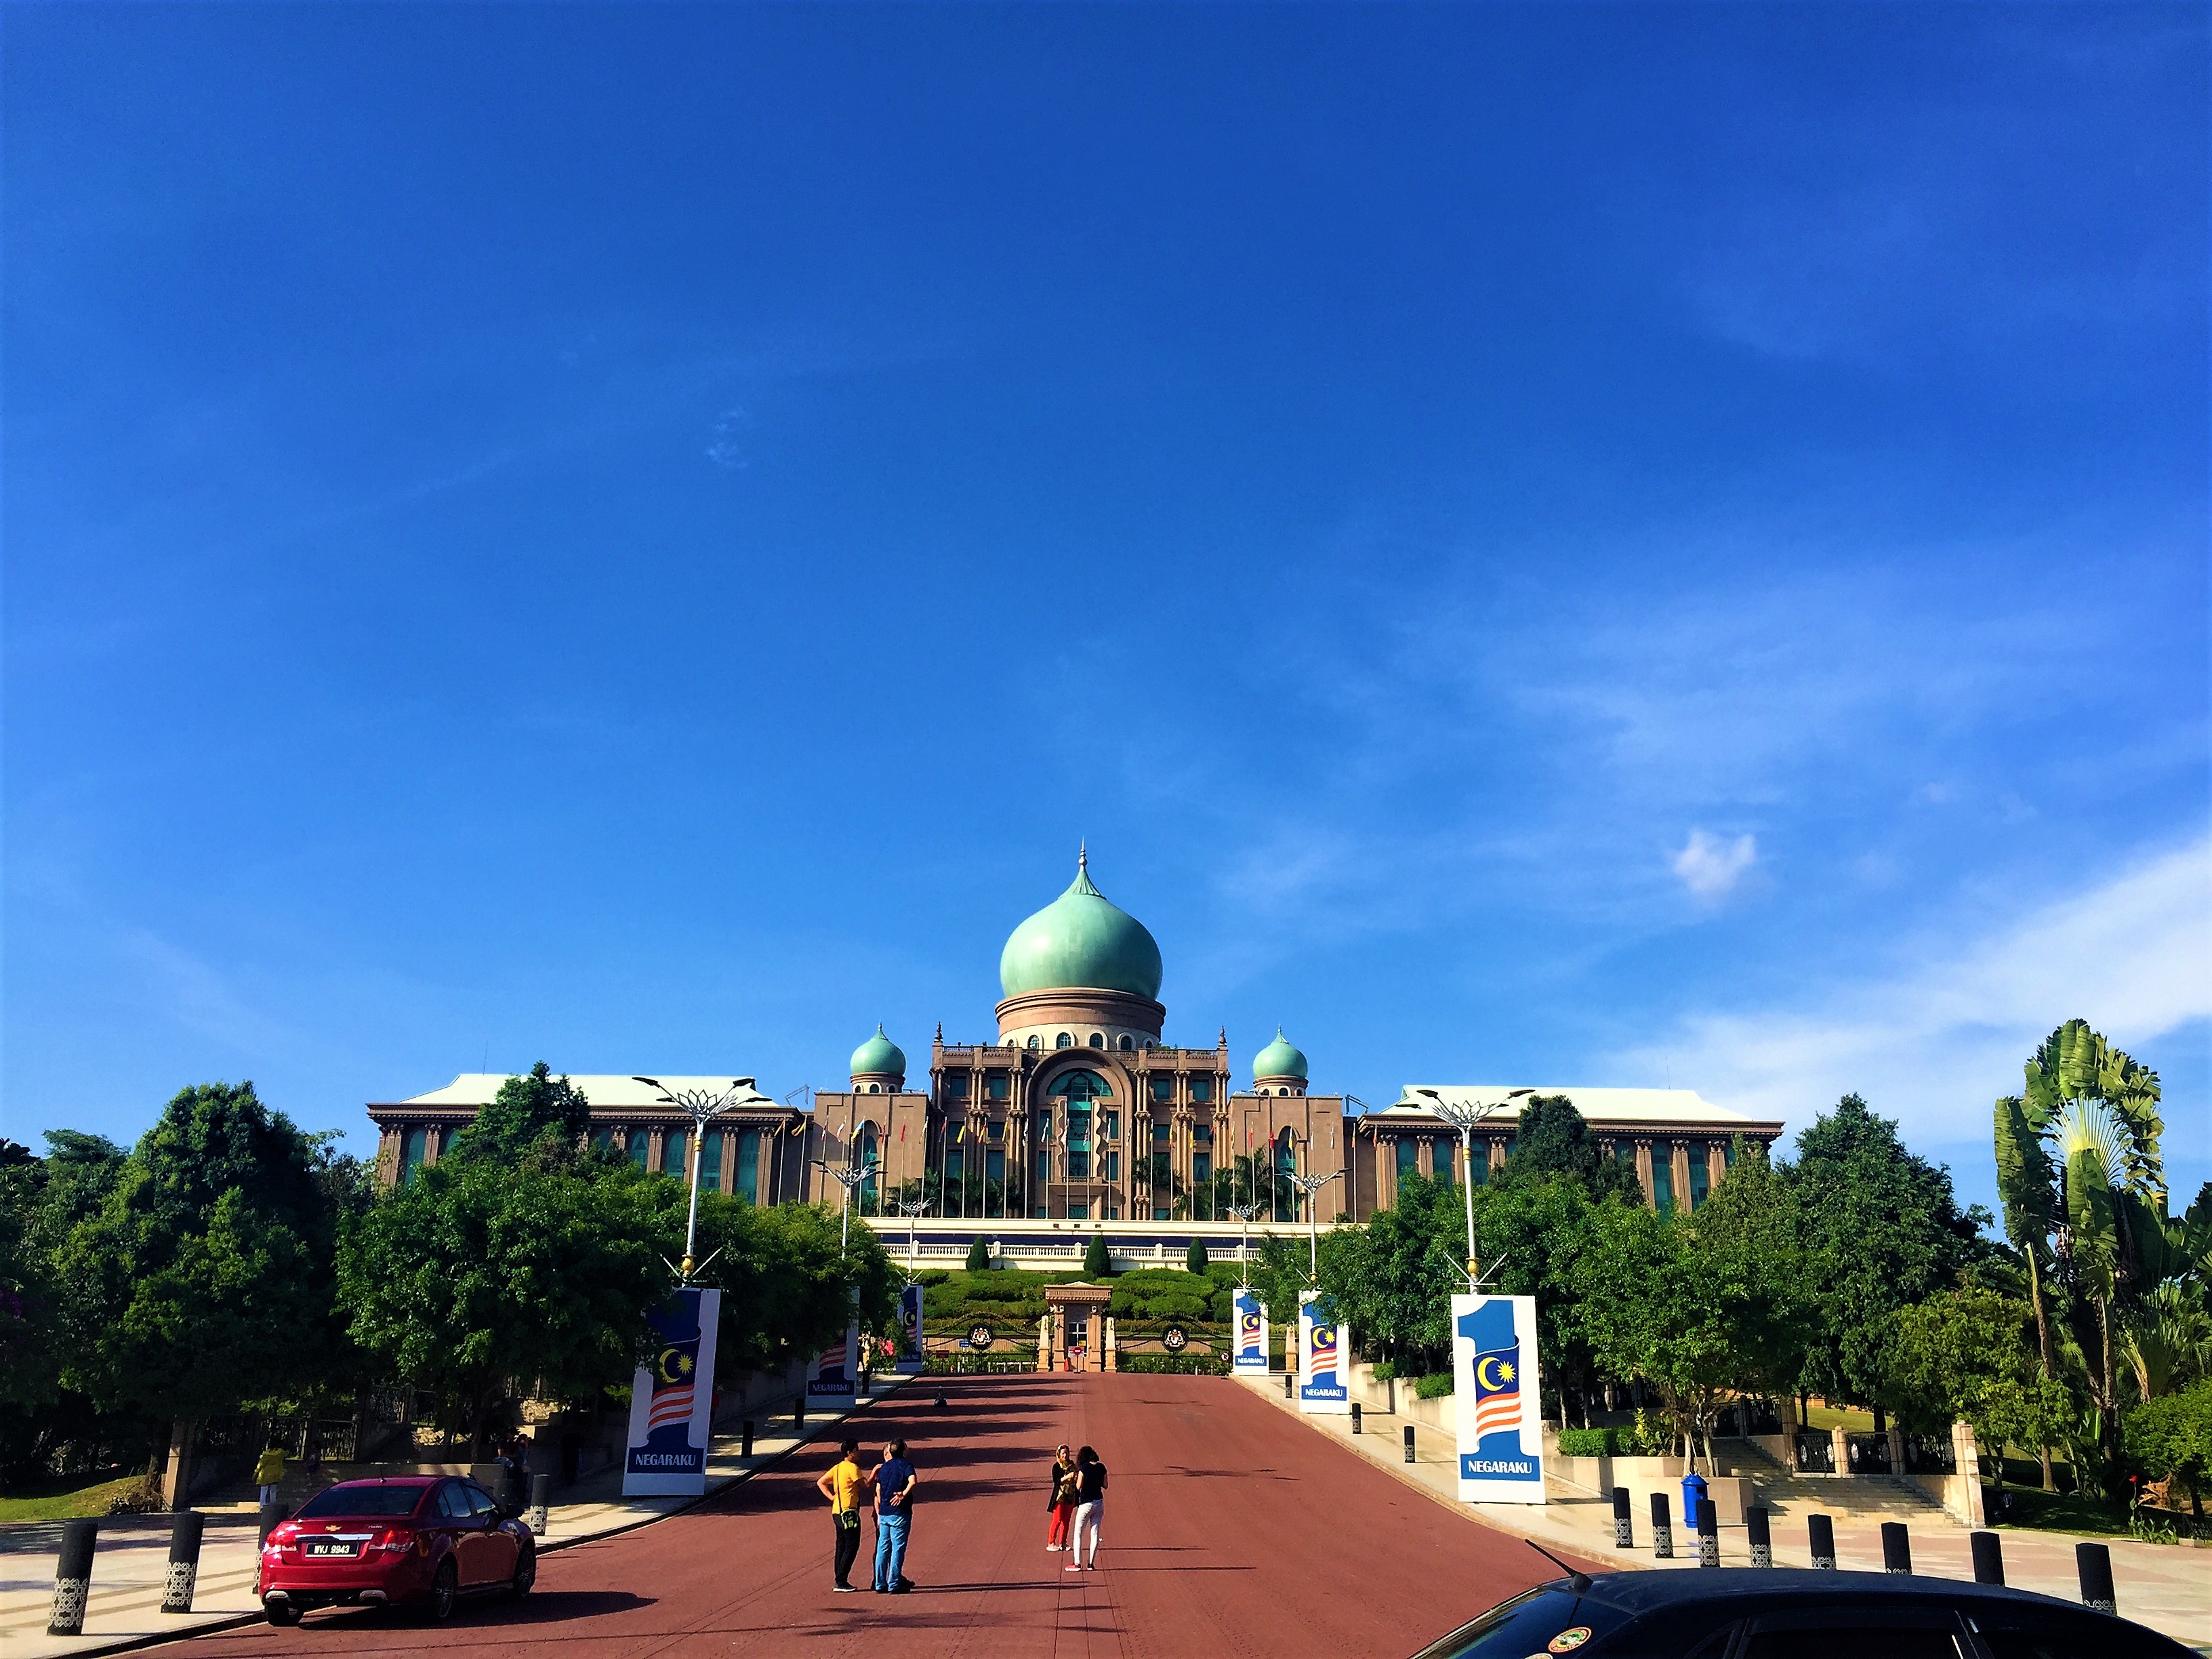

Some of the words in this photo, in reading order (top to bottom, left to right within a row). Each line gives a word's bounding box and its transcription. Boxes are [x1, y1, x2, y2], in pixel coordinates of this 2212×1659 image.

[1305, 1388, 1343, 1397] NEGARAKU
[636, 1454, 696, 1466] NEGARAKU
[1468, 1460, 1532, 1474] NEGARAKU
[314, 1545, 328, 1554] WVJ
[331, 1545, 350, 1554] 9943
